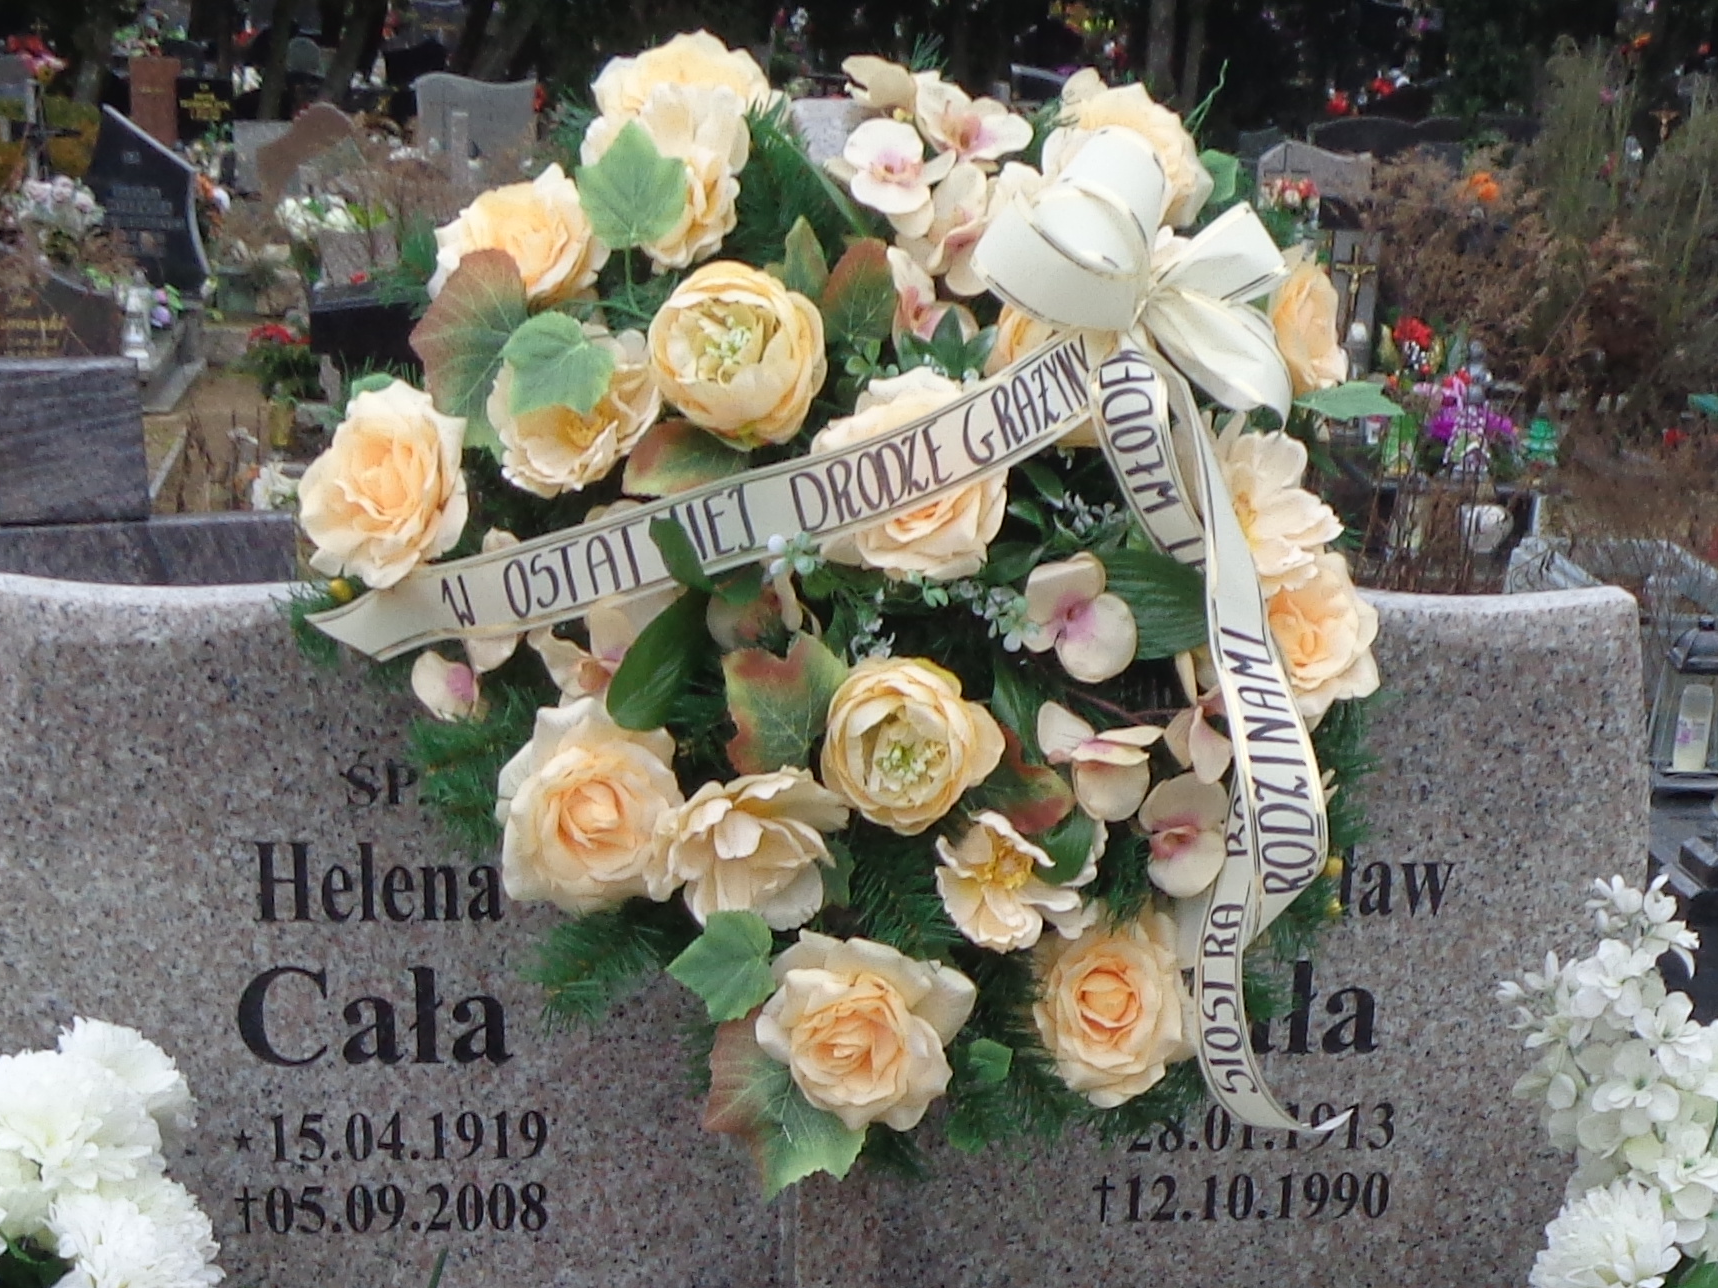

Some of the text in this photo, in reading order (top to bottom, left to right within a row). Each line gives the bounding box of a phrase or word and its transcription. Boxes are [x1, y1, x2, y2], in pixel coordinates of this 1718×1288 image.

[502, 489, 758, 619] OSTATIEJ
[255, 841, 504, 922] Helena
[238, 966, 514, 1068] Cała
[1201, 904, 1259, 1095] SIOSTRA
